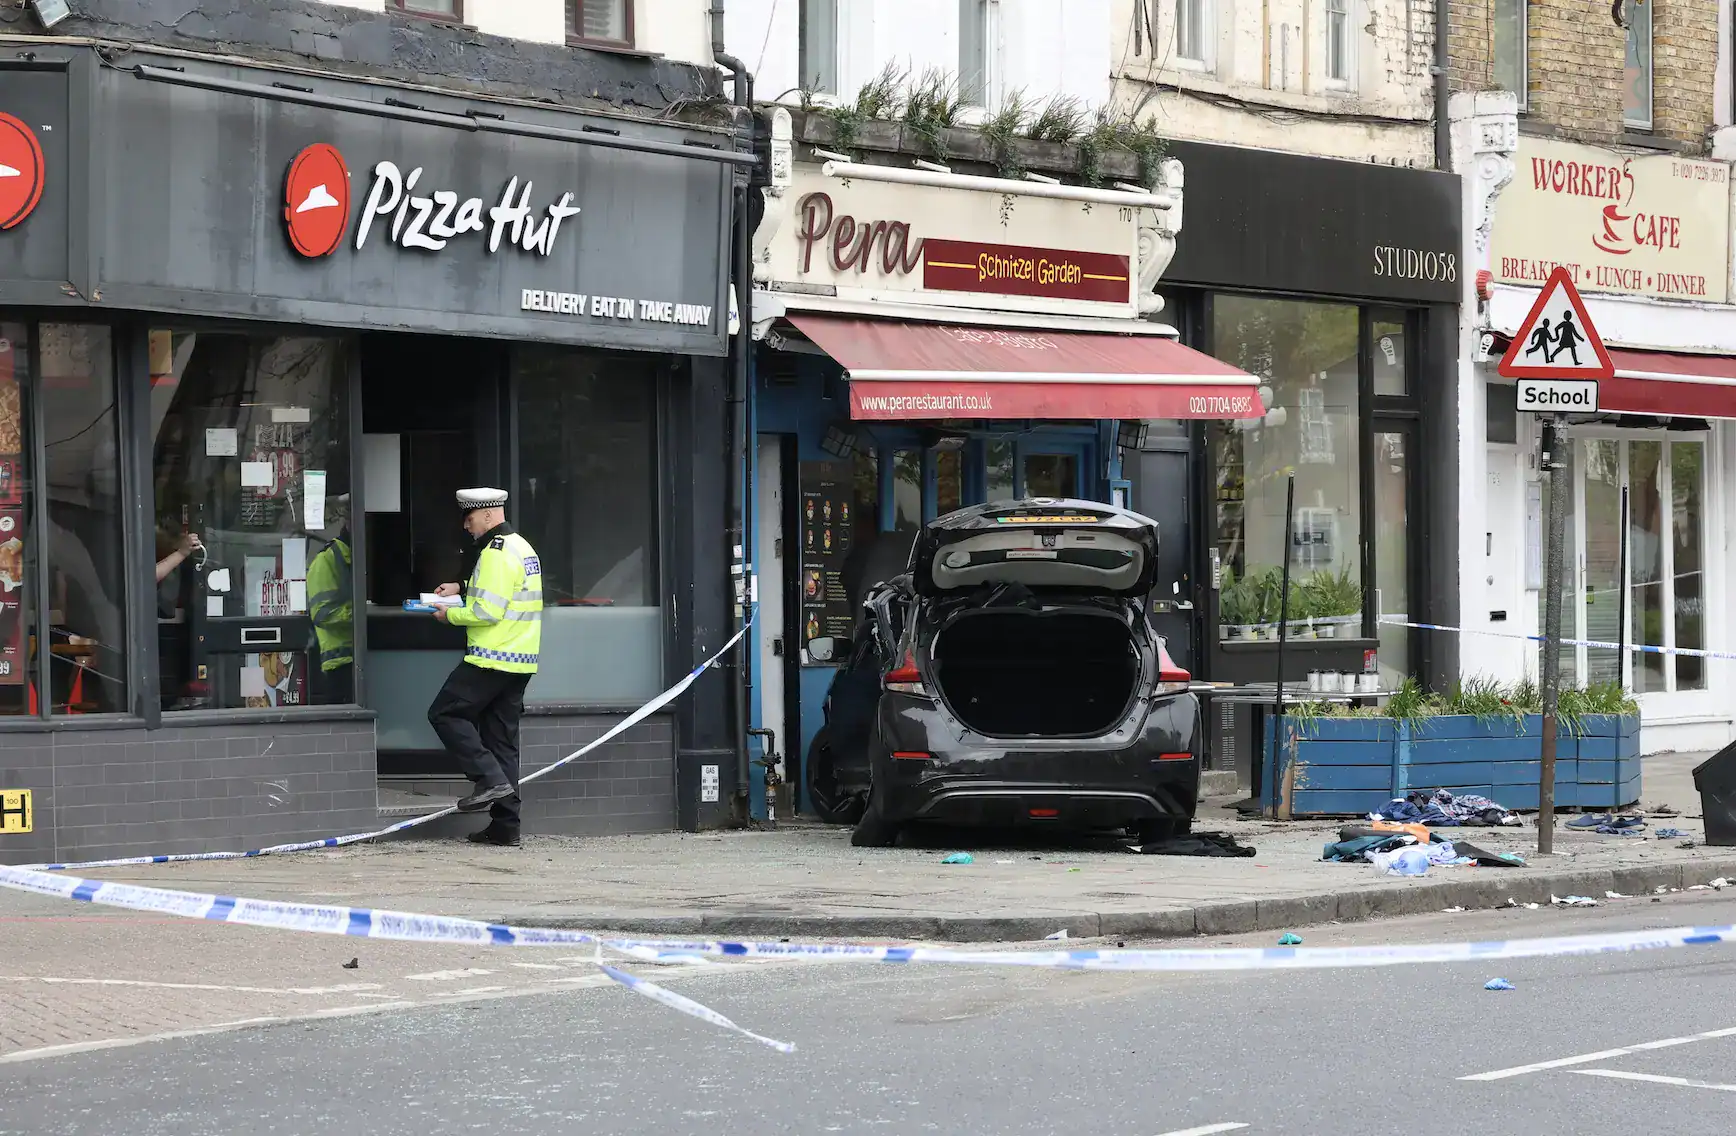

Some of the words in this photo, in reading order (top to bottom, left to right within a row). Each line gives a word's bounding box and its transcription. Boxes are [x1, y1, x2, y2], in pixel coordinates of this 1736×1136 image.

[1681, 163, 1693, 179] 020
[356, 160, 485, 251] Pizza
[489, 174, 582, 257] Hut
[1117, 206, 1132, 223] 170
[795, 190, 926, 276] Pera
[1633, 212, 1681, 253] CAFE
[978, 252, 1036, 284] Schnitzel
[1037, 257, 1082, 285] Garden
[1373, 244, 1457, 283] STUDIO58
[1501, 256, 1582, 284] BREAKST
[1596, 265, 1643, 290] LUNCH
[1657, 272, 1706, 296] DINNER
[520, 288, 588, 315] DELIVERY
[591, 295, 617, 318] EAT
[617, 298, 635, 320] IN
[639, 300, 673, 323] TAKE
[673, 303, 712, 326] AWAY
[860, 391, 993, 415] www.perarestaurant.co.uk
[1189, 396, 1207, 413] 020
[1208, 396, 1231, 413] 7704
[1524, 385, 1591, 406] School
[705, 766, 716, 775] GAS
[0, 793, 26, 829] H
